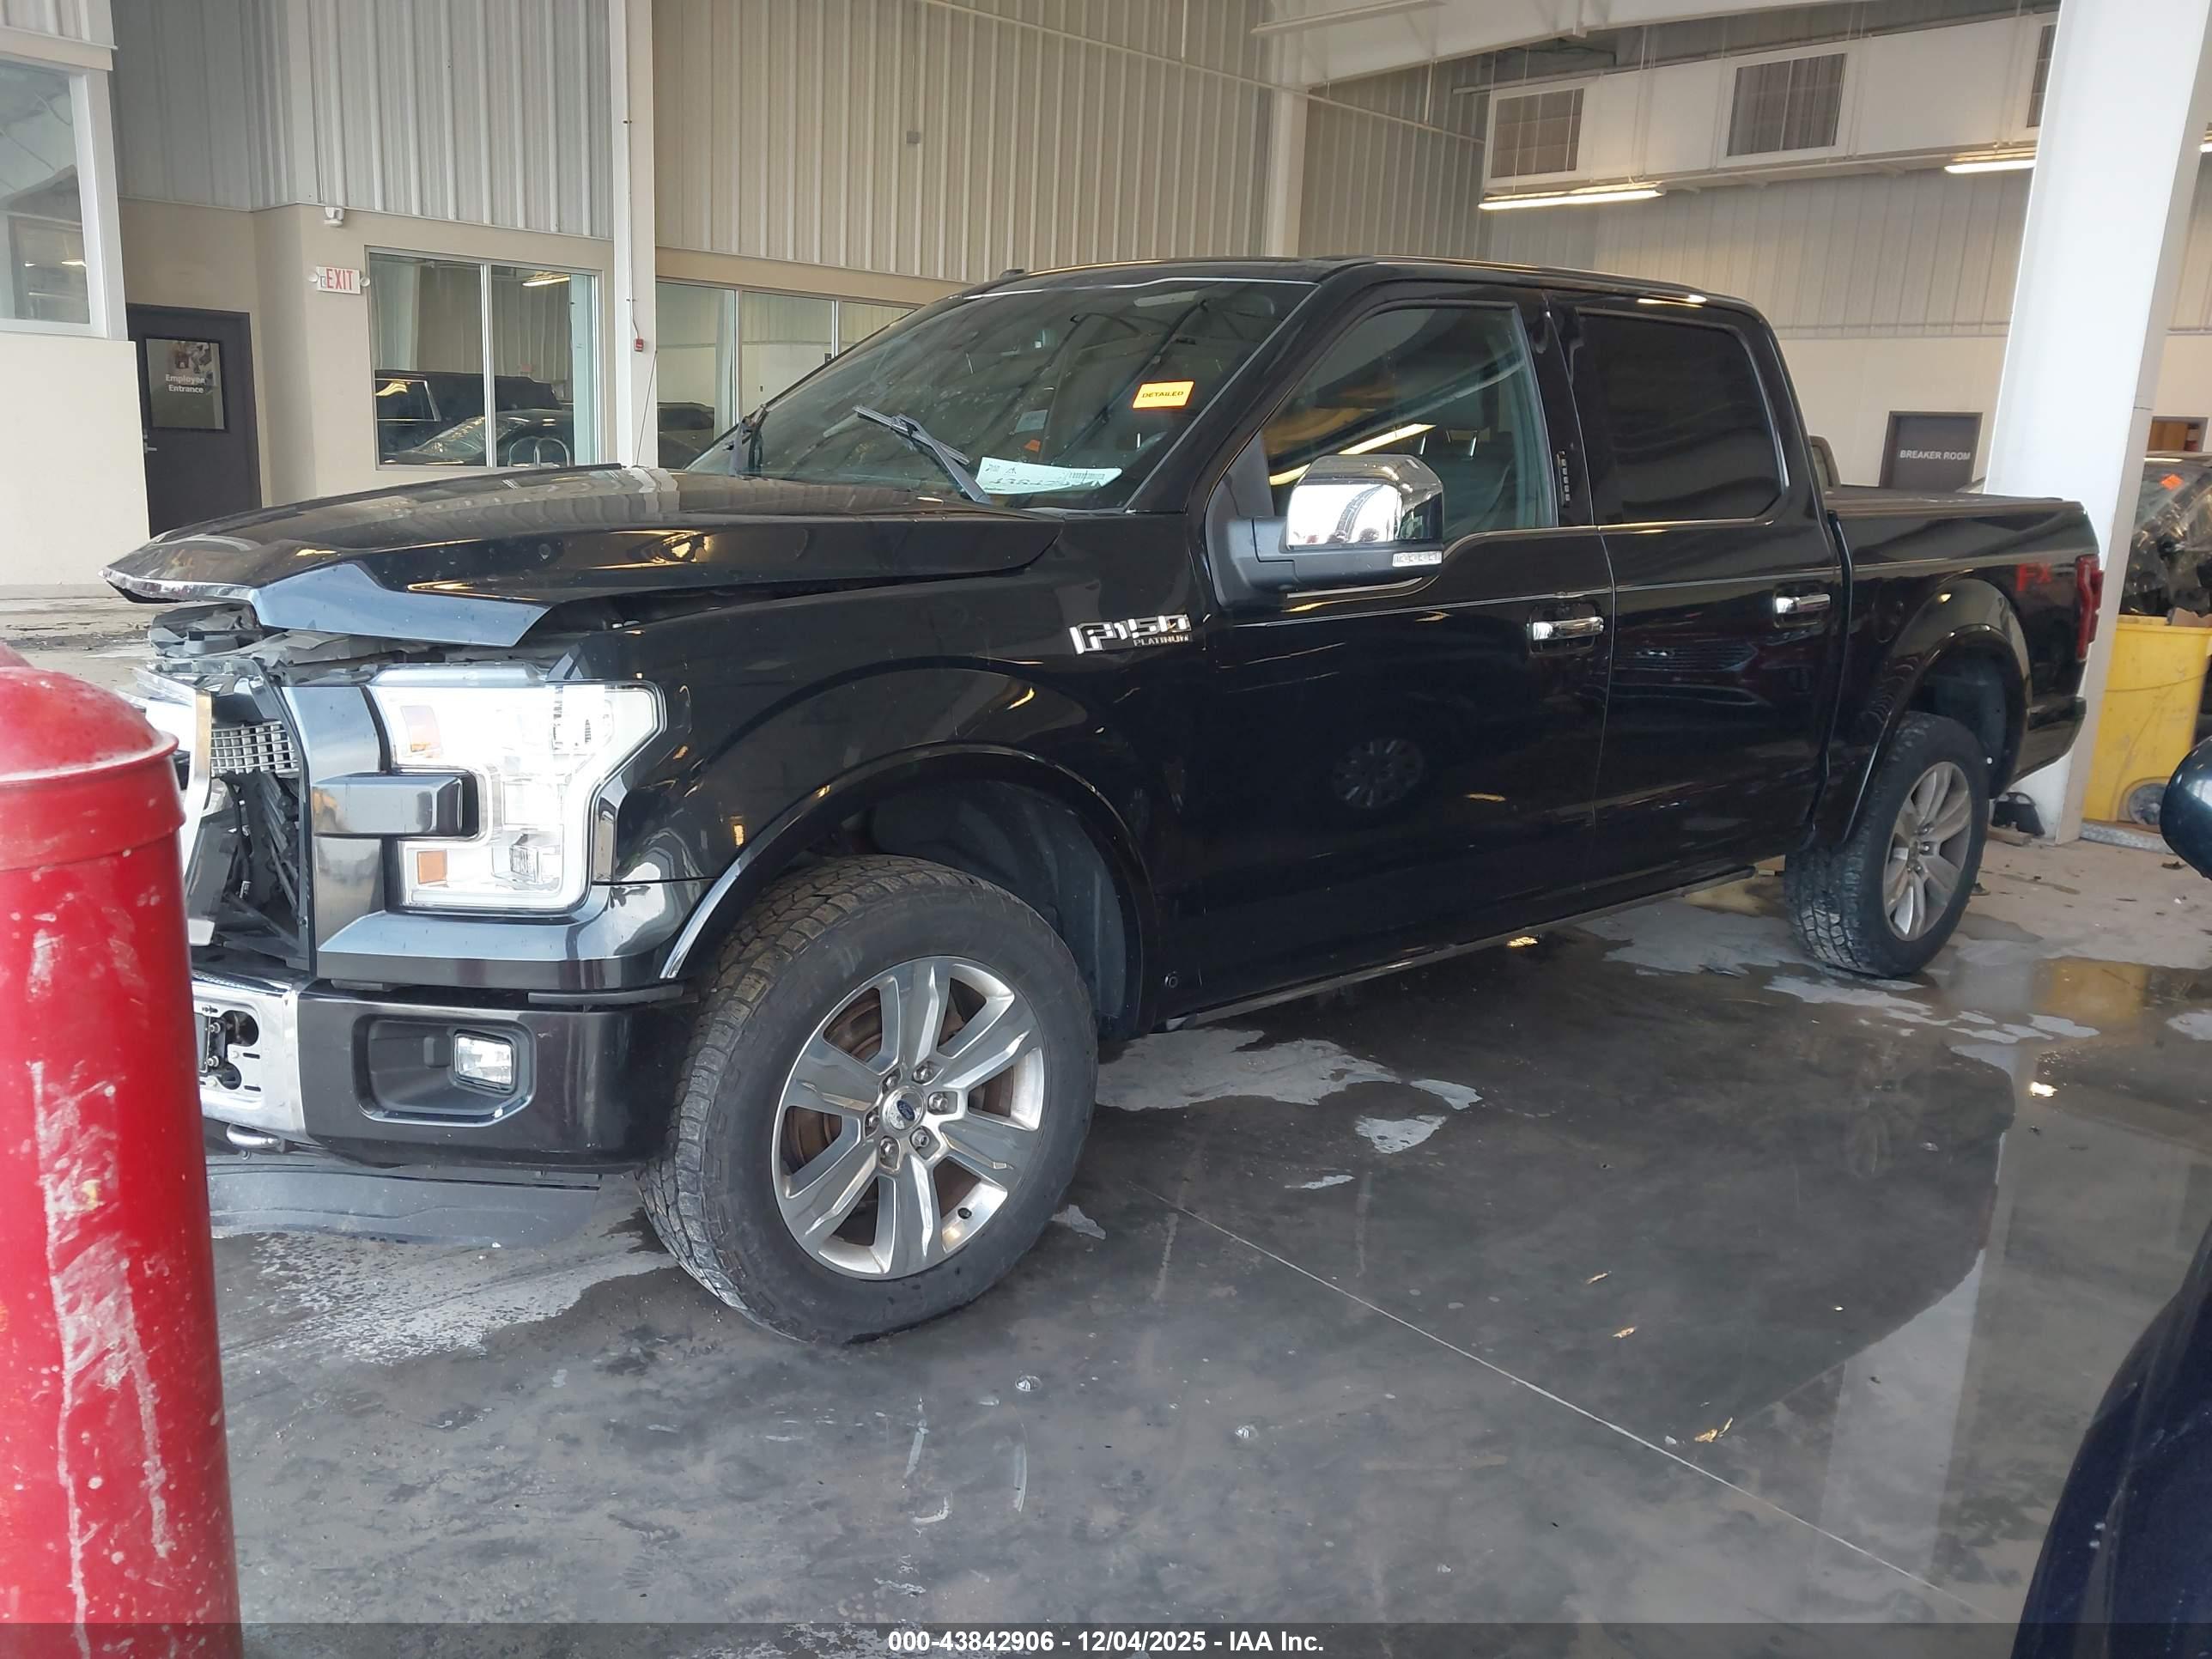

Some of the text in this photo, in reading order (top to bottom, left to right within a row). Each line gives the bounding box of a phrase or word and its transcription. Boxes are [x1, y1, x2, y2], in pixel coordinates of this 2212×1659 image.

[326, 268, 353, 290] EXIT
[165, 374, 205, 385] Employee
[168, 384, 204, 394] Entrance
[1899, 449, 1971, 461] BREAKER ROOM
[1133, 635, 1190, 647] PLATINUM
